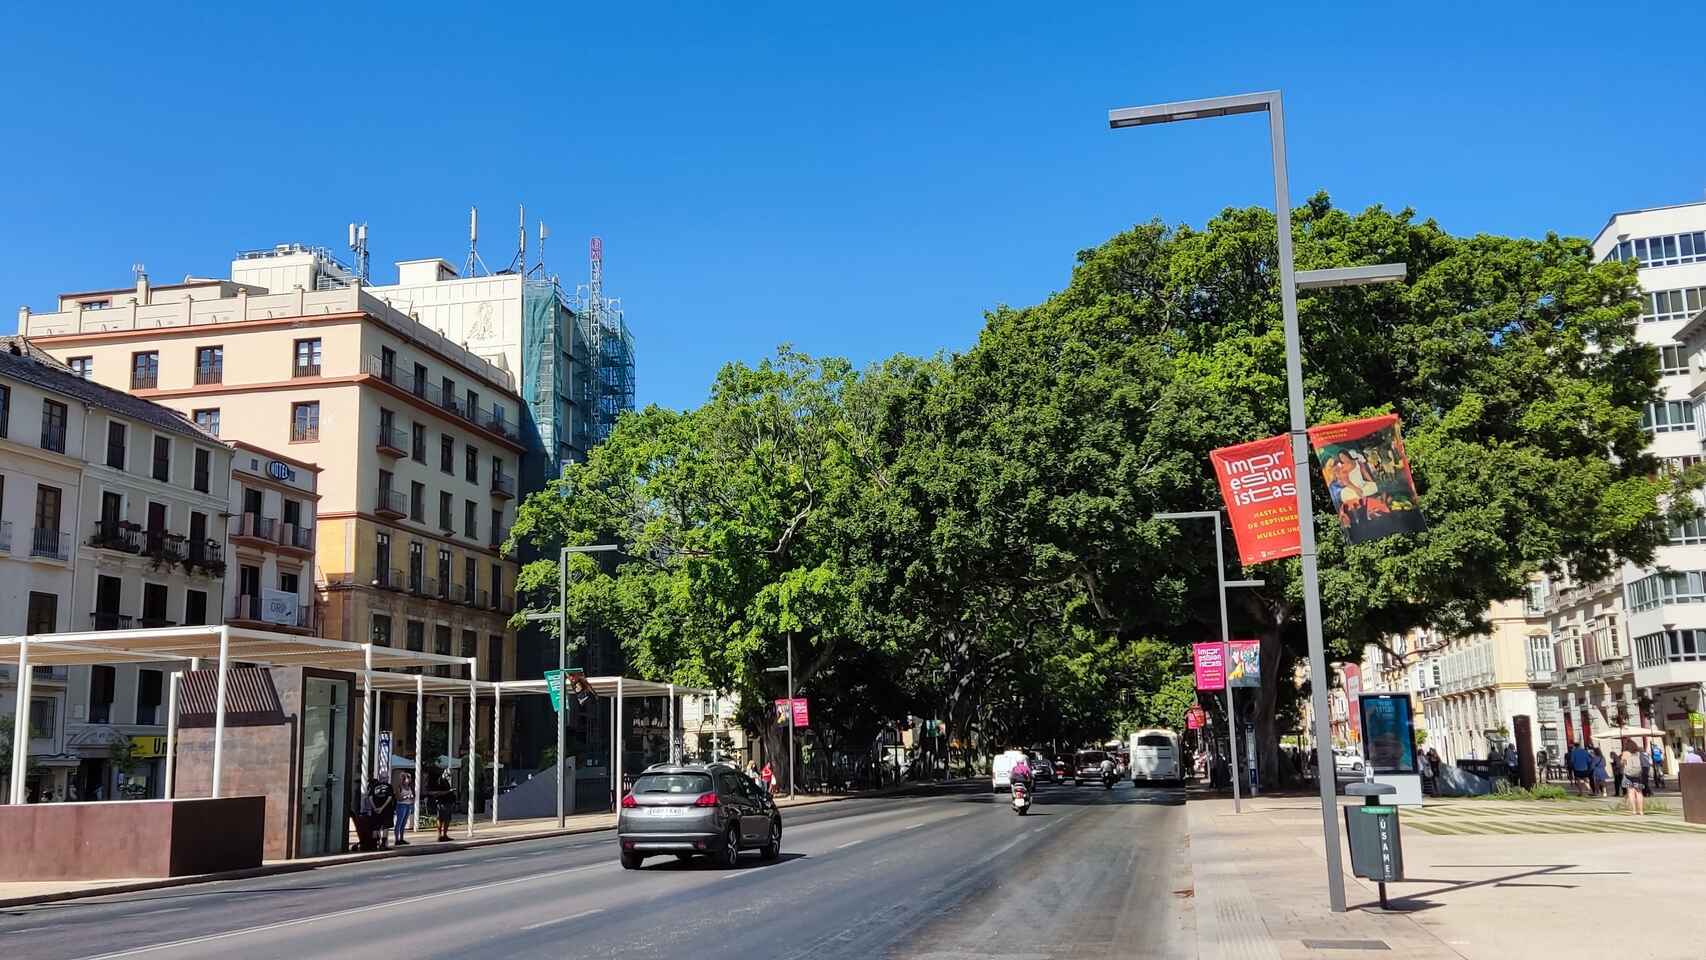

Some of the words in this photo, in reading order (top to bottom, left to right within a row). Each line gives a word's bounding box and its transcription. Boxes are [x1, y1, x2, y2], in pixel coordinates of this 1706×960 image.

[270, 462, 289, 480] HOTEL
[1224, 451, 1285, 475] Impr
[1234, 483, 1297, 506] istas
[1261, 514, 1299, 528] SEPTIEMBR
